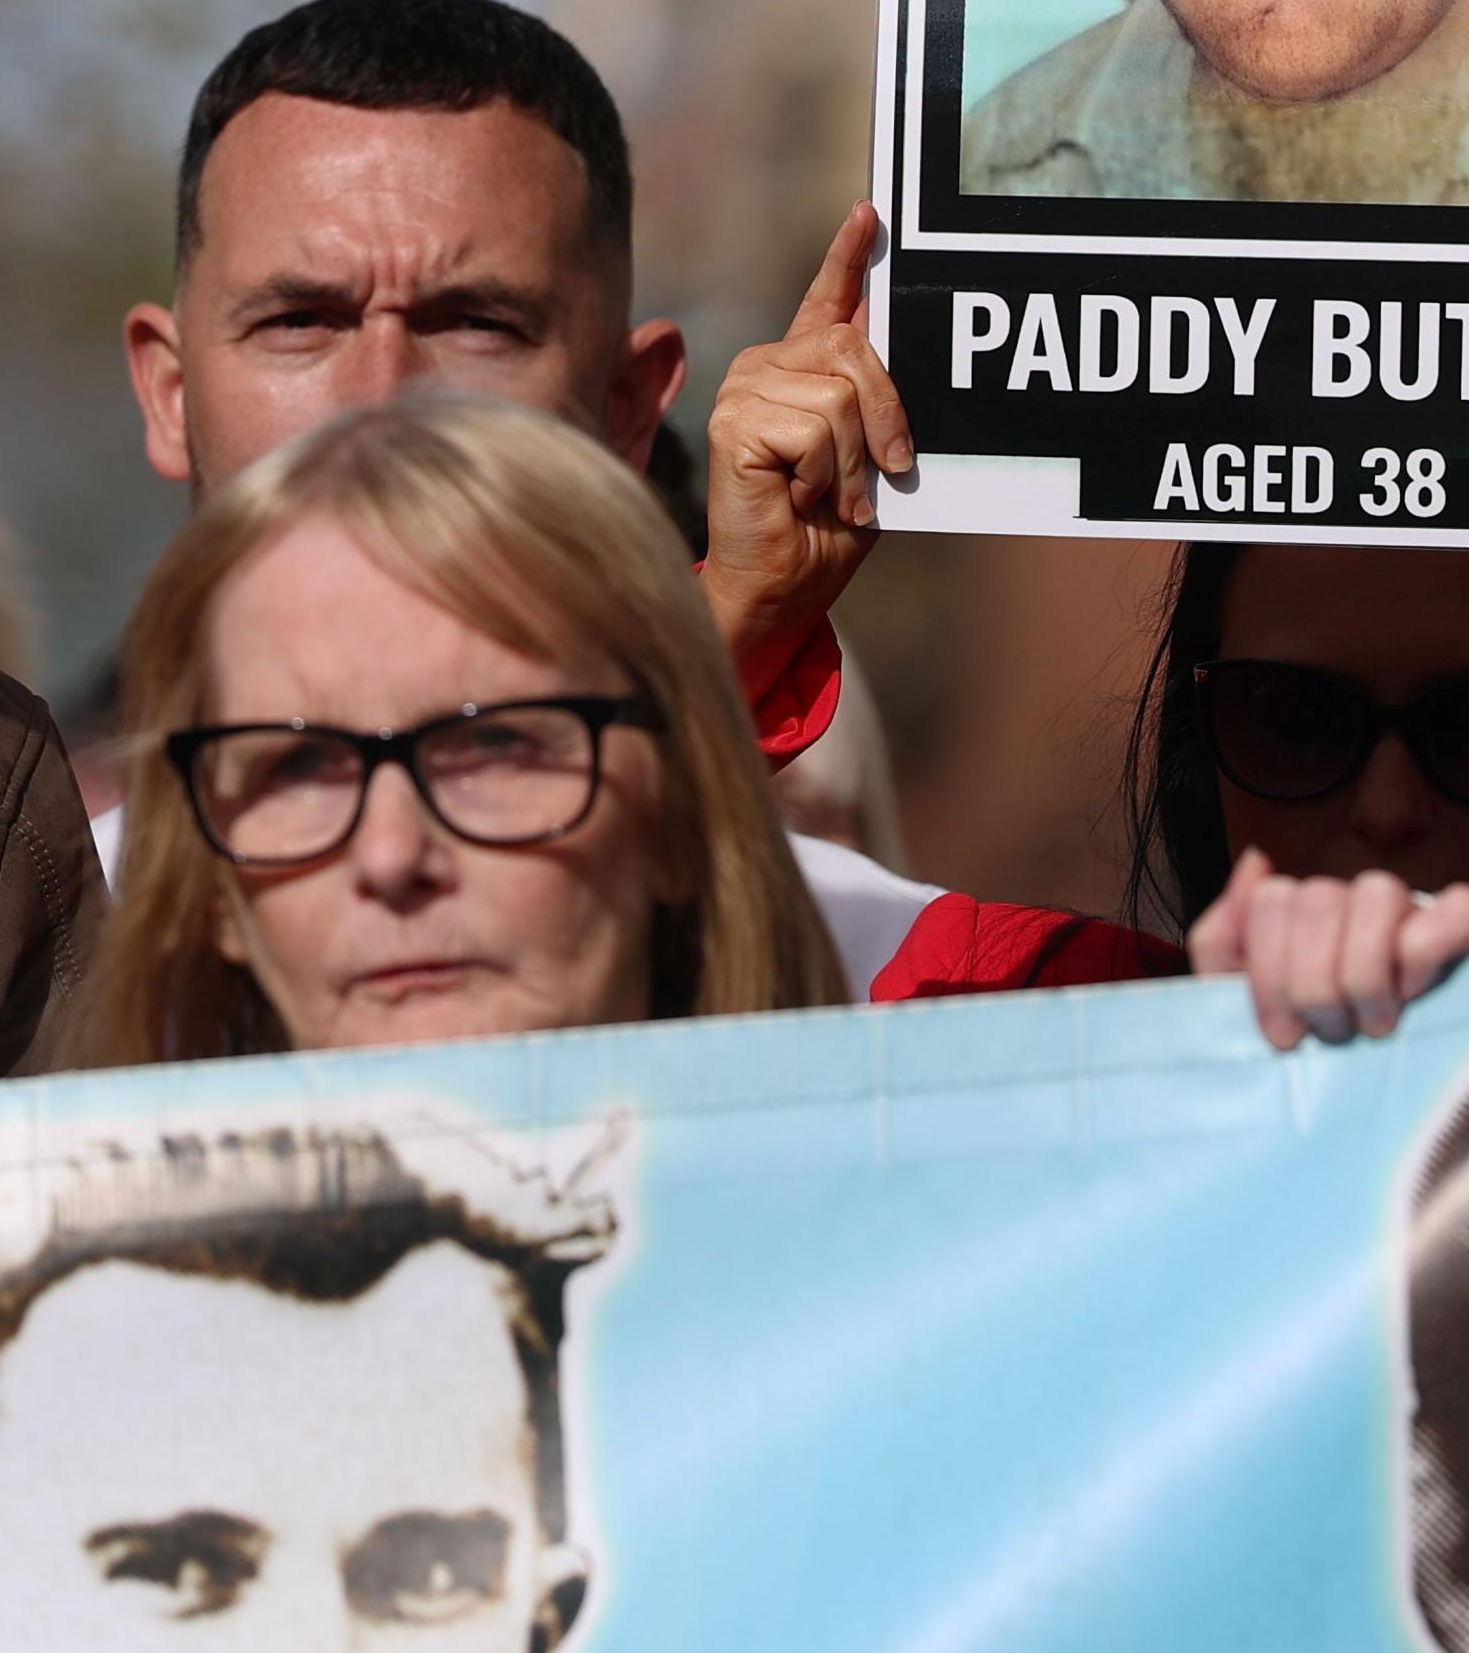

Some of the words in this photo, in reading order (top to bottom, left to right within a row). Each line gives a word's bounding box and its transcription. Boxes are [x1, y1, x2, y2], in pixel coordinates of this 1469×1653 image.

[950, 290, 1277, 397] PADDY
[1152, 442, 1335, 515] AGED
[1359, 446, 1448, 519] 38
